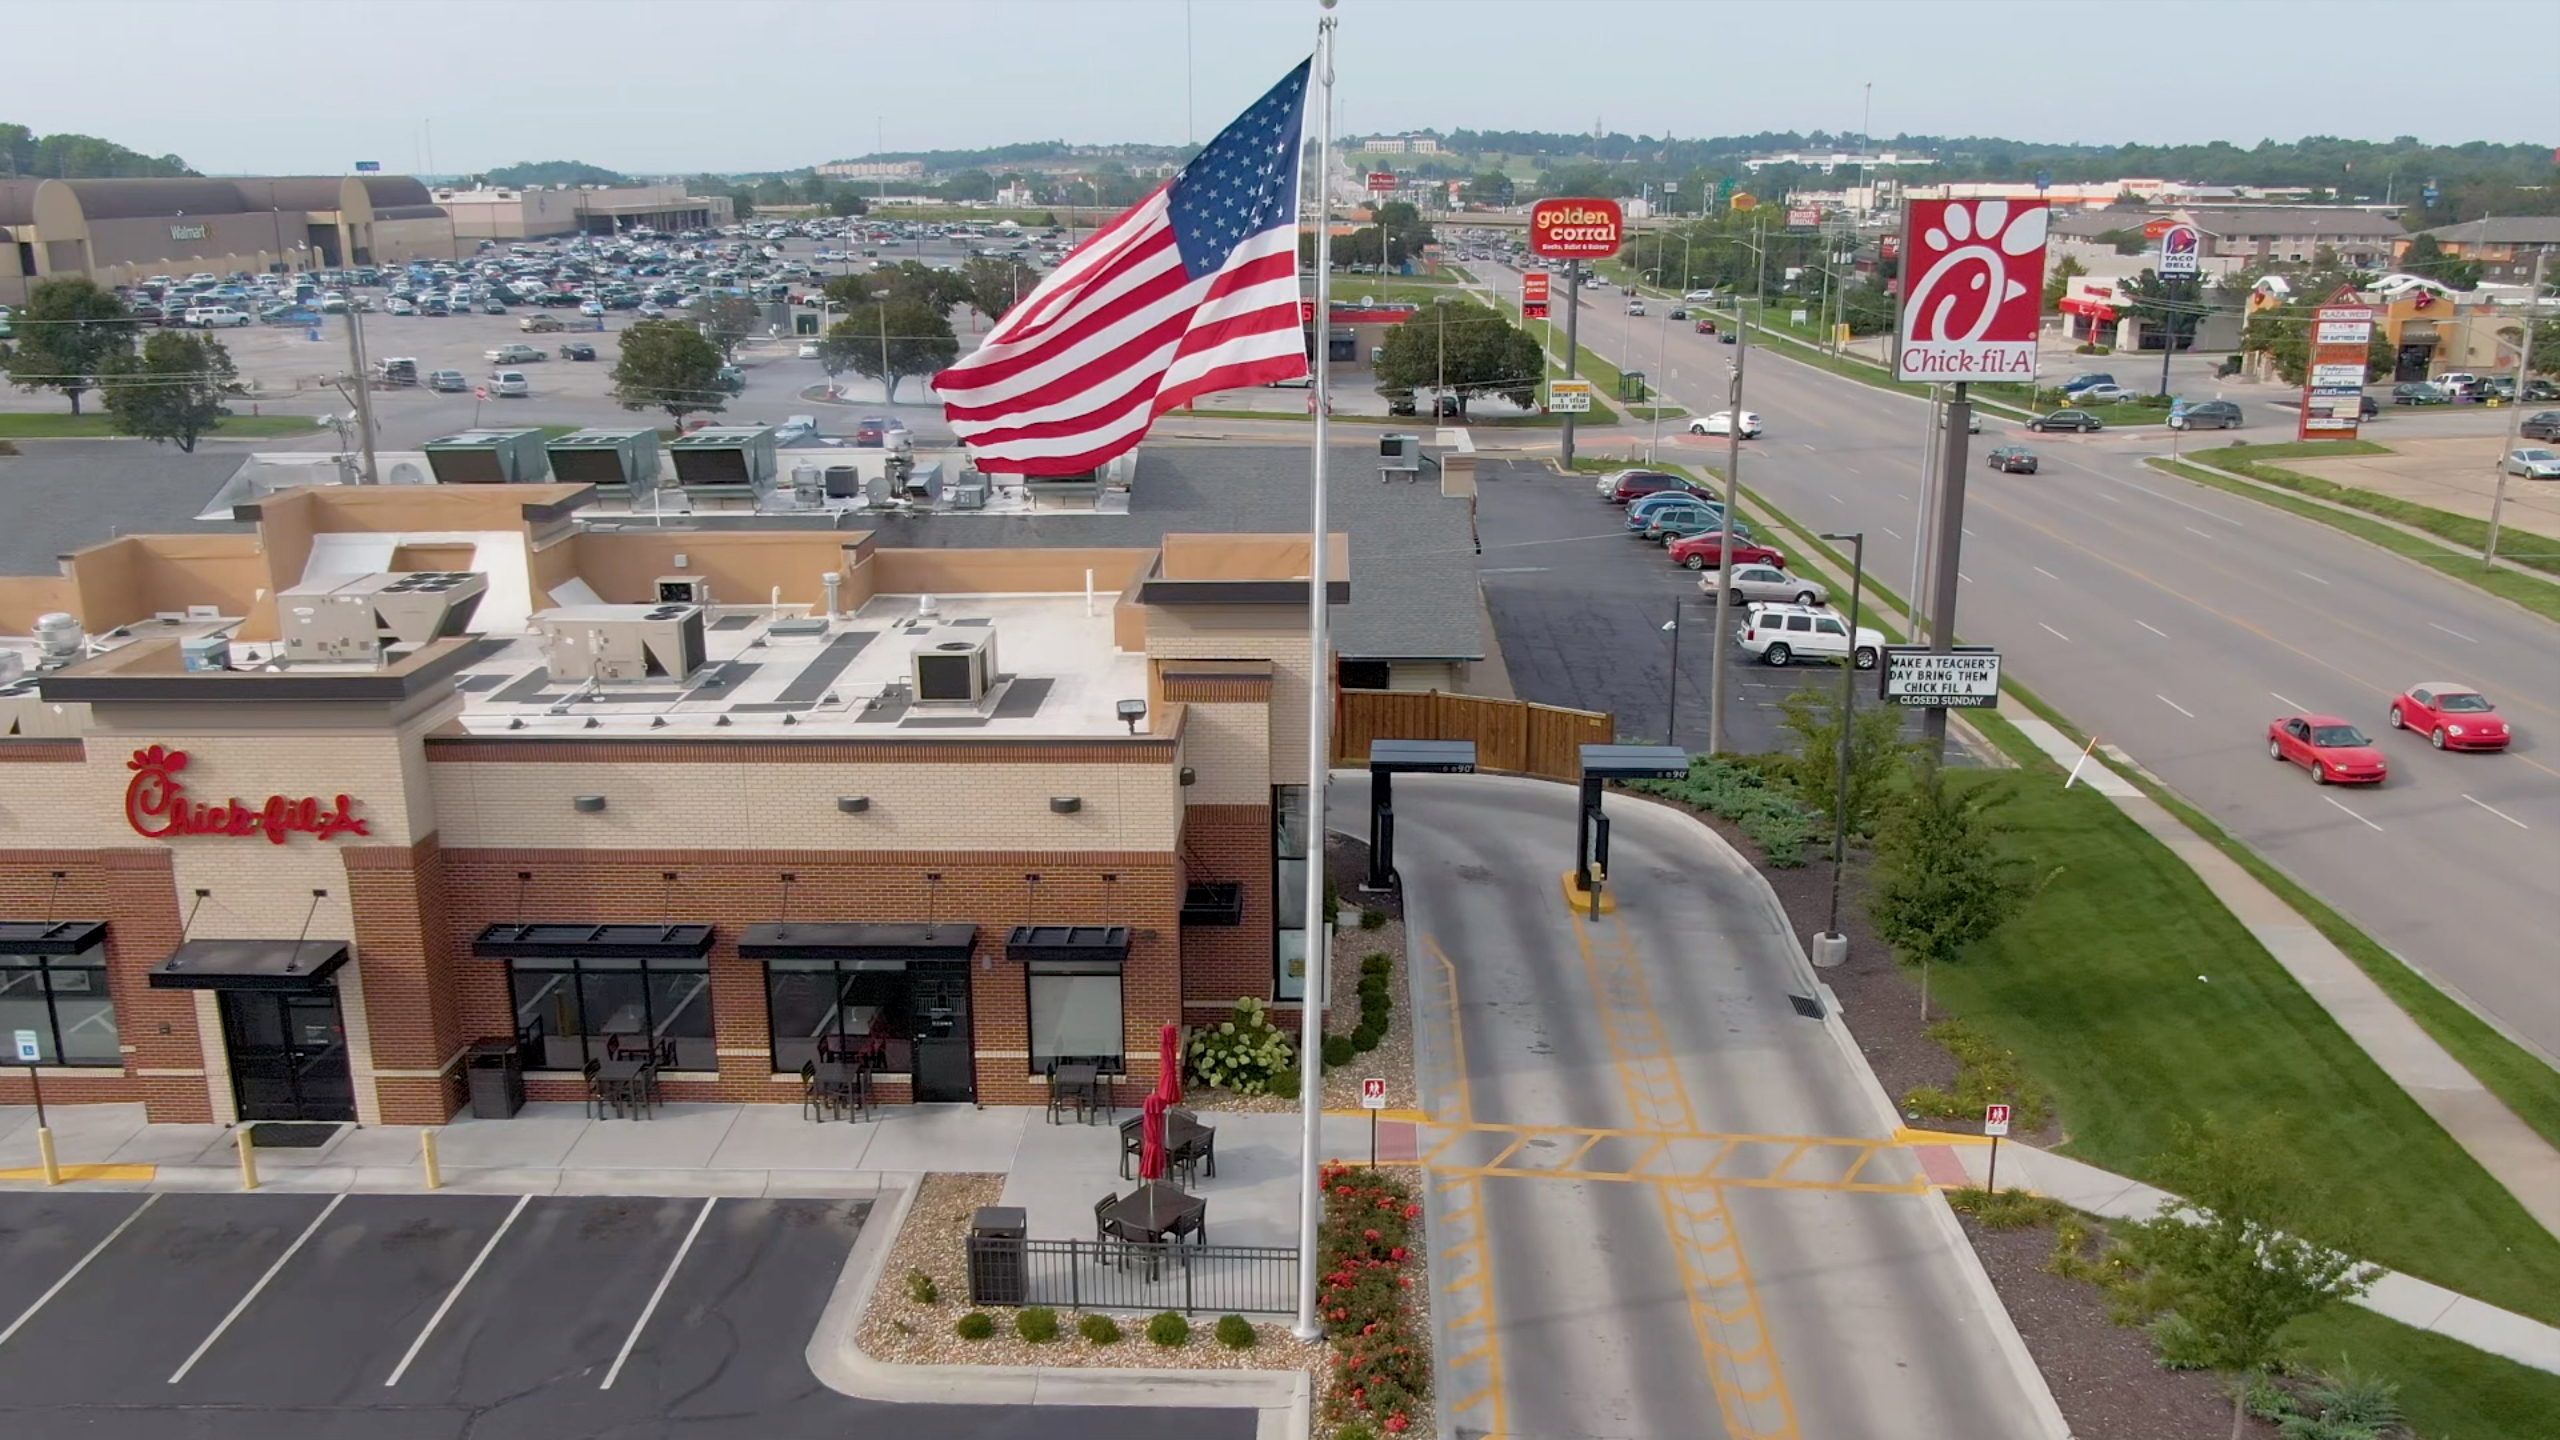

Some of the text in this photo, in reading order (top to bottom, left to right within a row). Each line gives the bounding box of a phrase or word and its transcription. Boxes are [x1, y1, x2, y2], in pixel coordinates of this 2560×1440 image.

[1537, 207, 1610, 229] golden
[170, 224, 206, 240] Walmart
[1550, 223, 1617, 241] corral
[1902, 348, 2031, 373] Chick-fil-A
[1891, 658, 1996, 669] MAKE A TEACHER'S
[1890, 671, 1988, 681] DAY BRING THEM
[1904, 683, 1973, 693] CHICK FIL A
[1900, 695, 1984, 705] CLOSED SUNDAY
[125, 744, 370, 845] Chick-fil-A
